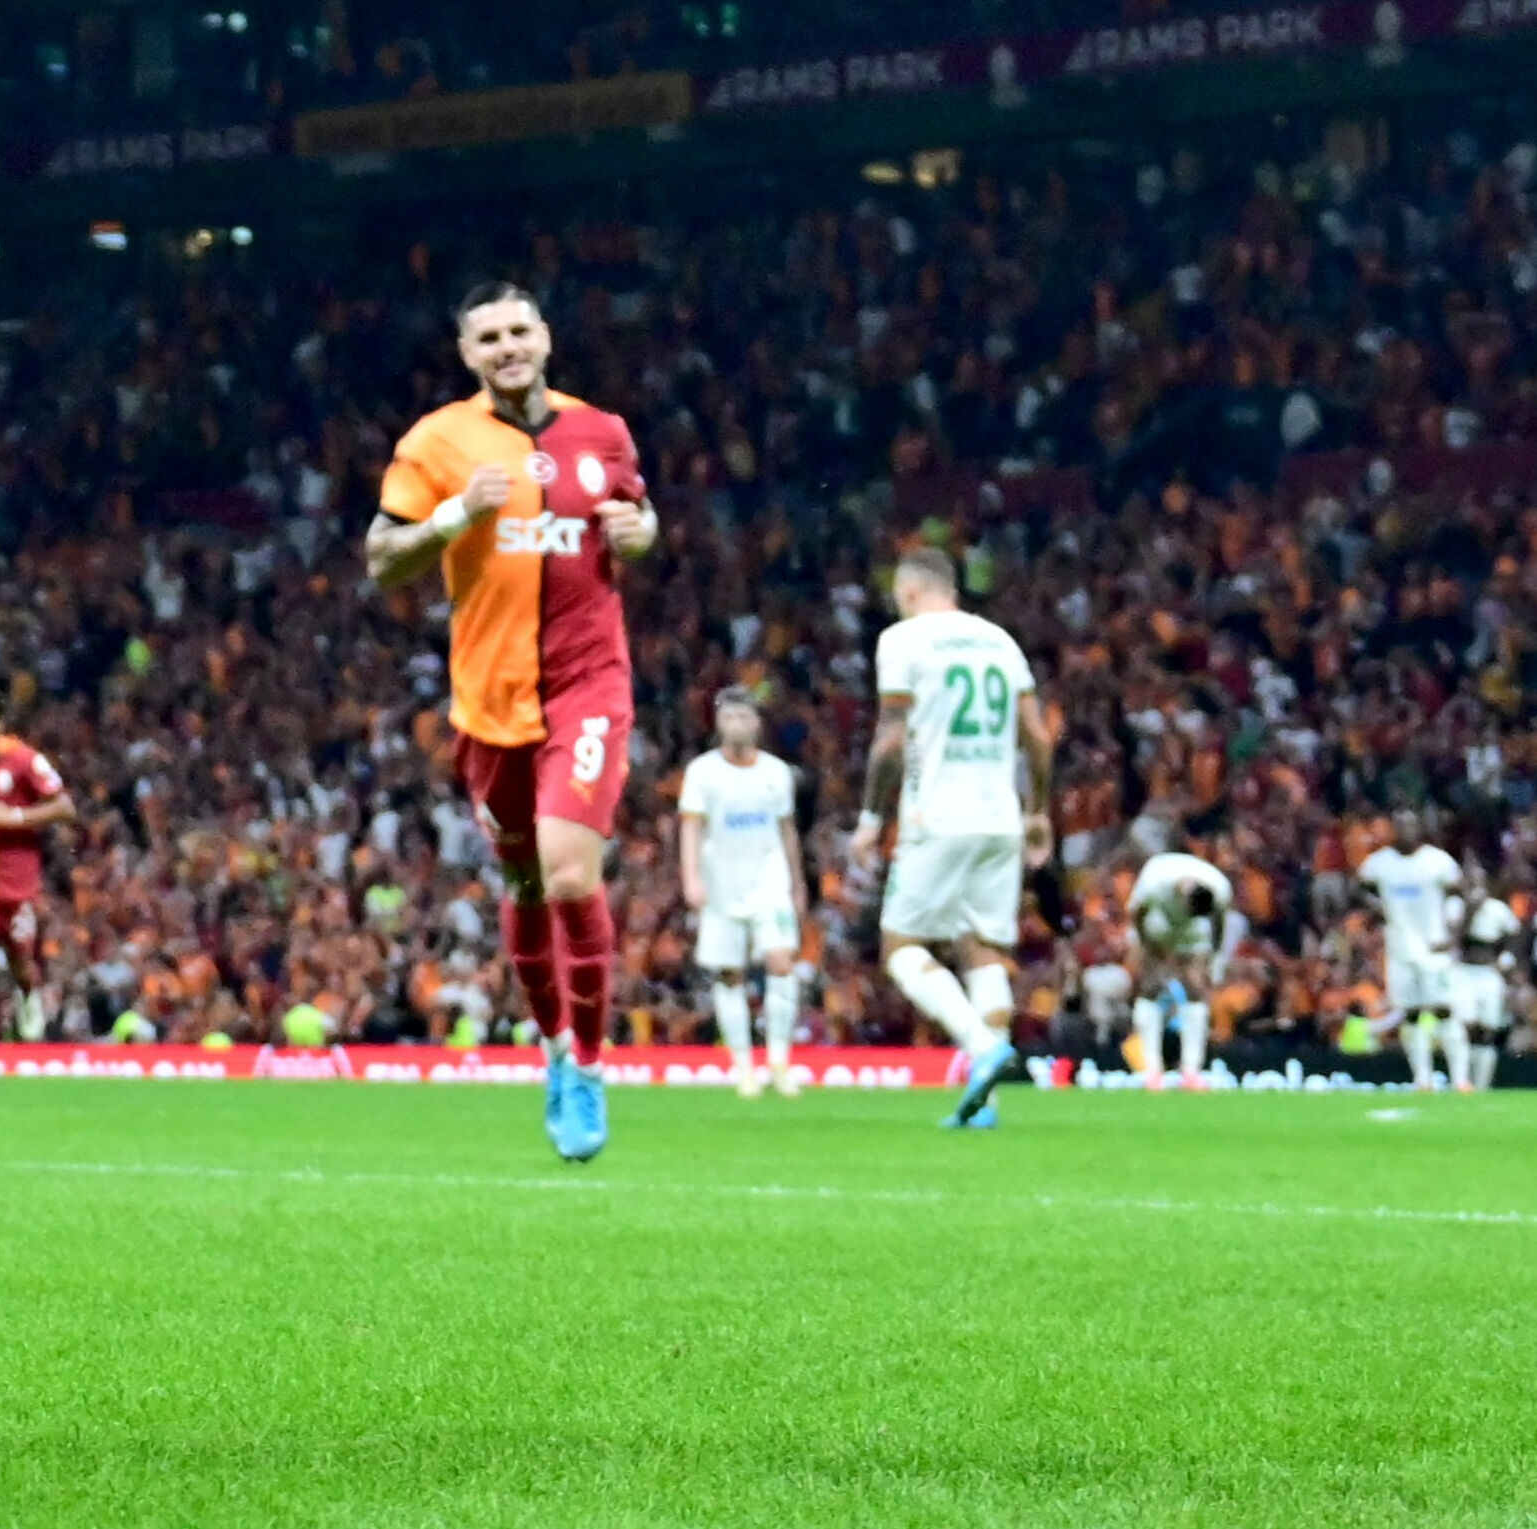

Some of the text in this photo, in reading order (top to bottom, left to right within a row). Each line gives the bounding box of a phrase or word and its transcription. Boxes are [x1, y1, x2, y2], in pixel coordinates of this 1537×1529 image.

[1097, 7, 1322, 64] RAMS PARK
[944, 663, 1010, 738] 29
[573, 735, 606, 783] 9
